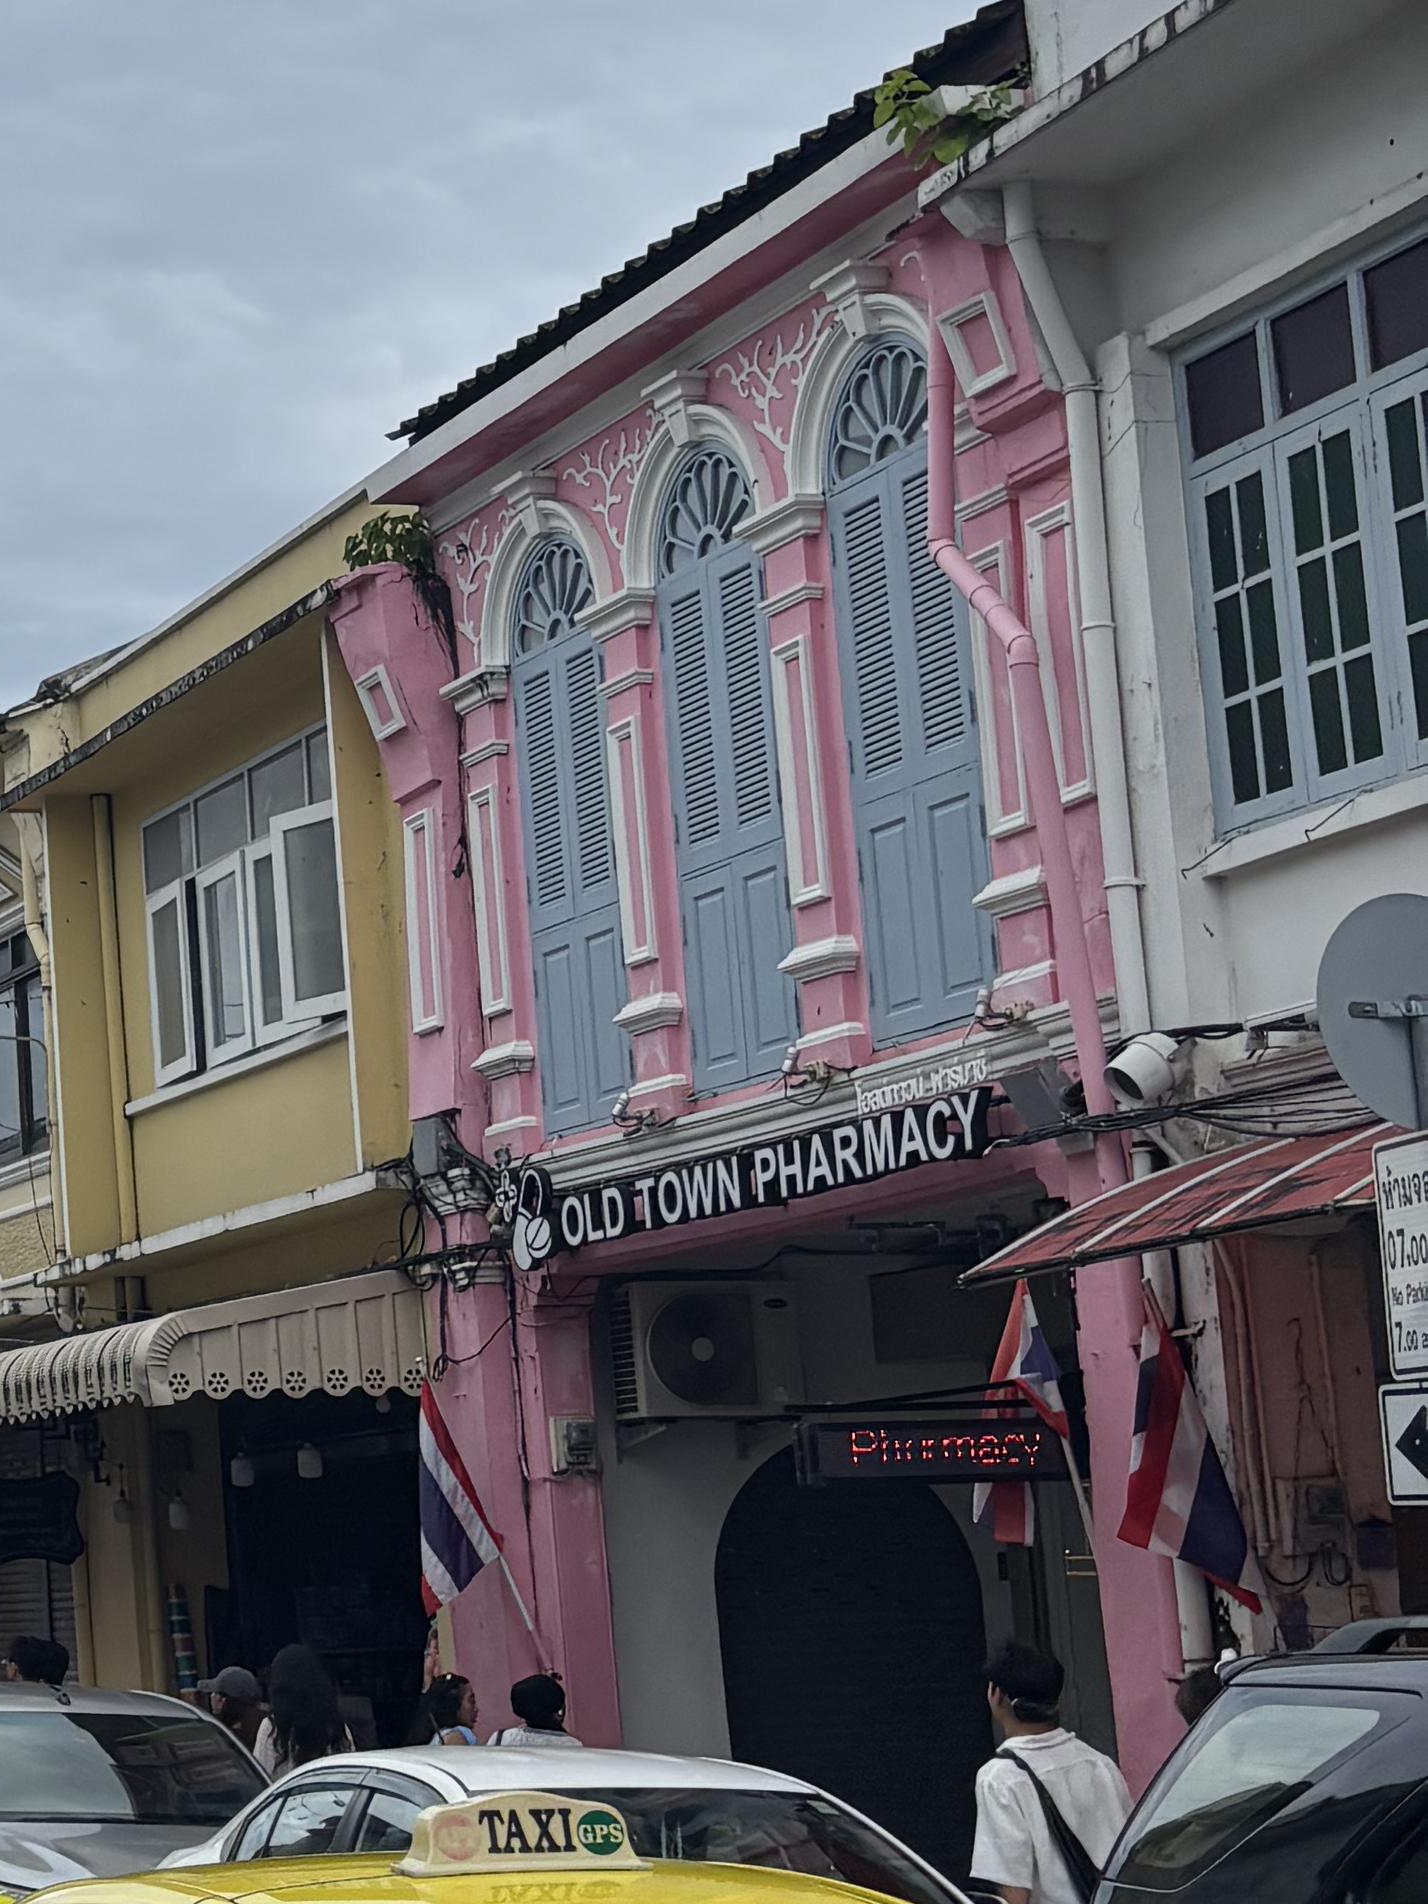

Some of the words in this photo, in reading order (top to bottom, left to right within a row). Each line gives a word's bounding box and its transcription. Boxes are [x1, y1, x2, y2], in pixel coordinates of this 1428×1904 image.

[561, 1186, 625, 1248] OLD
[634, 1155, 742, 1230] TOWN
[754, 1091, 982, 1203] PHARMACY
[478, 1808, 577, 1854] TAXI
[578, 1823, 624, 1845] GPS
